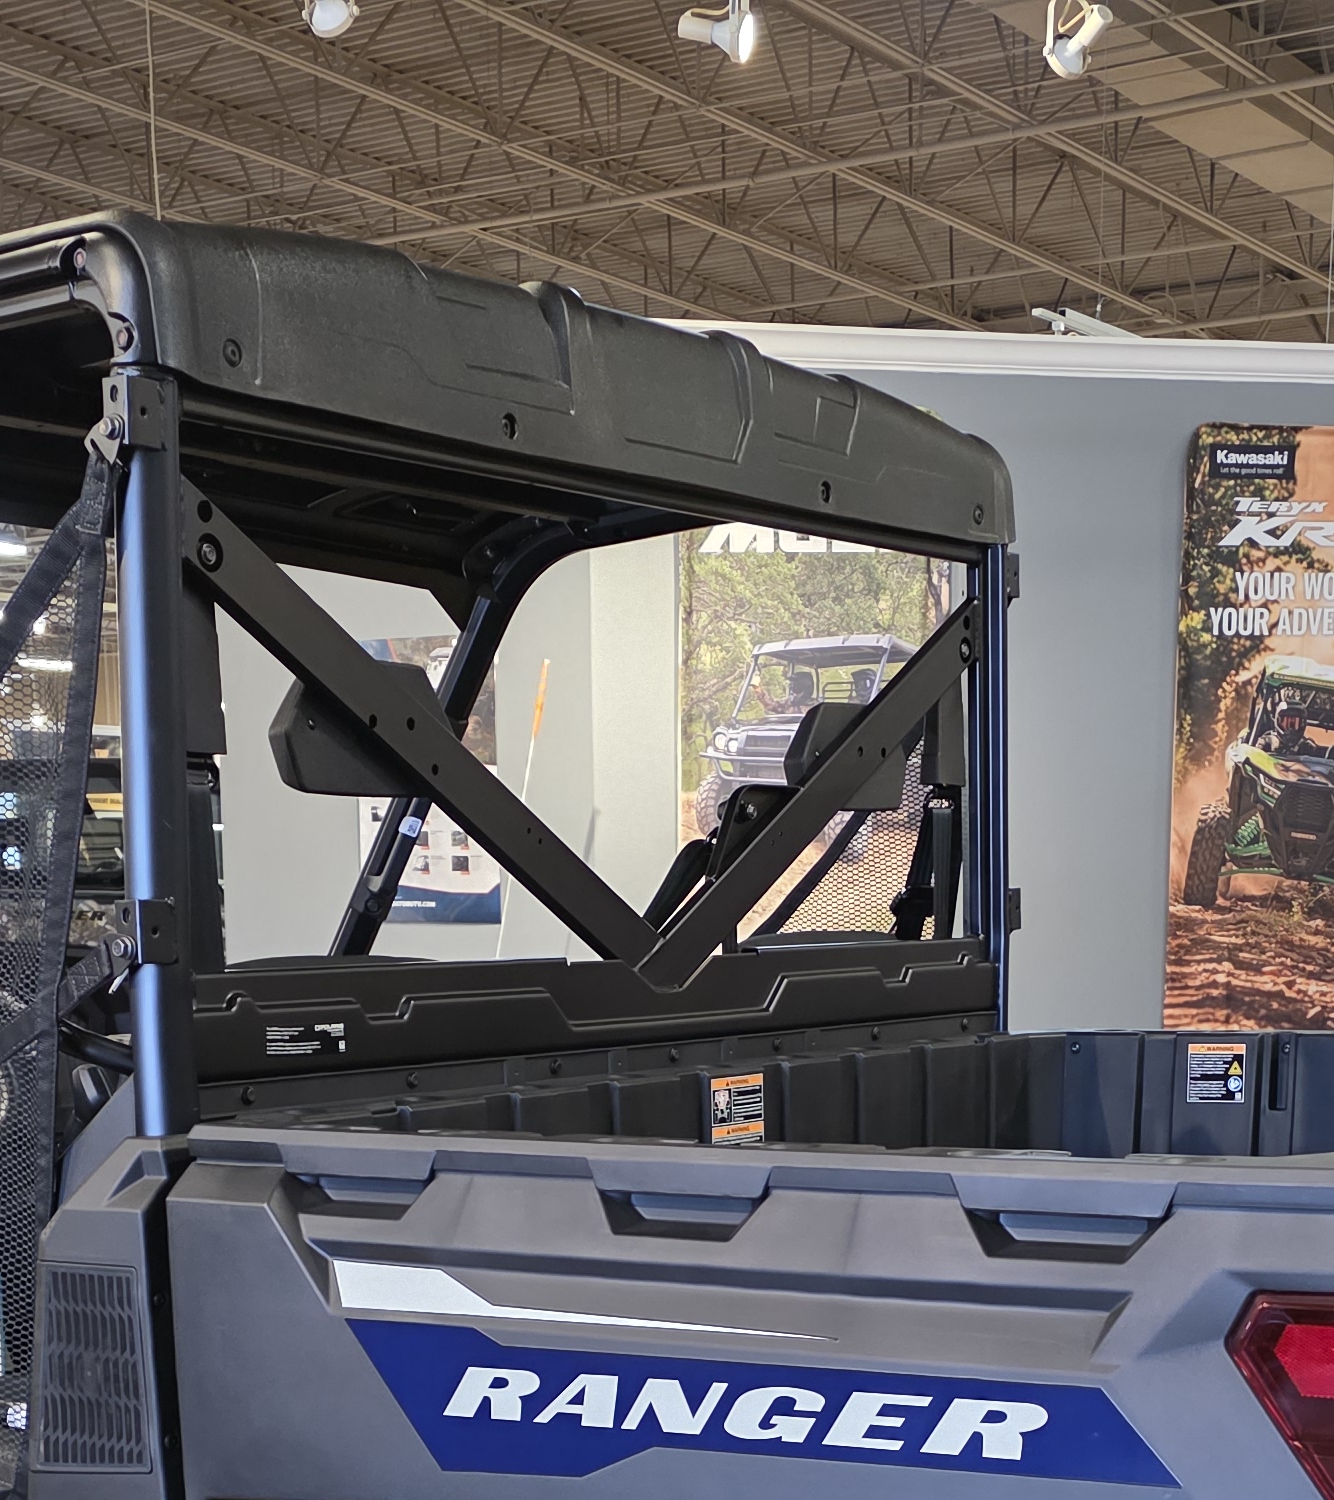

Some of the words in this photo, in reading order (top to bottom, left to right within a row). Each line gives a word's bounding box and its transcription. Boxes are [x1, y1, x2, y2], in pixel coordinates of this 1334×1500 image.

[1216, 449, 1289, 465] Kawasaki
[1235, 571, 1295, 600] YOUR
[1209, 606, 1269, 636] YOUR
[72, 909, 106, 921] ER
[443, 1365, 1049, 1462] RANGER
